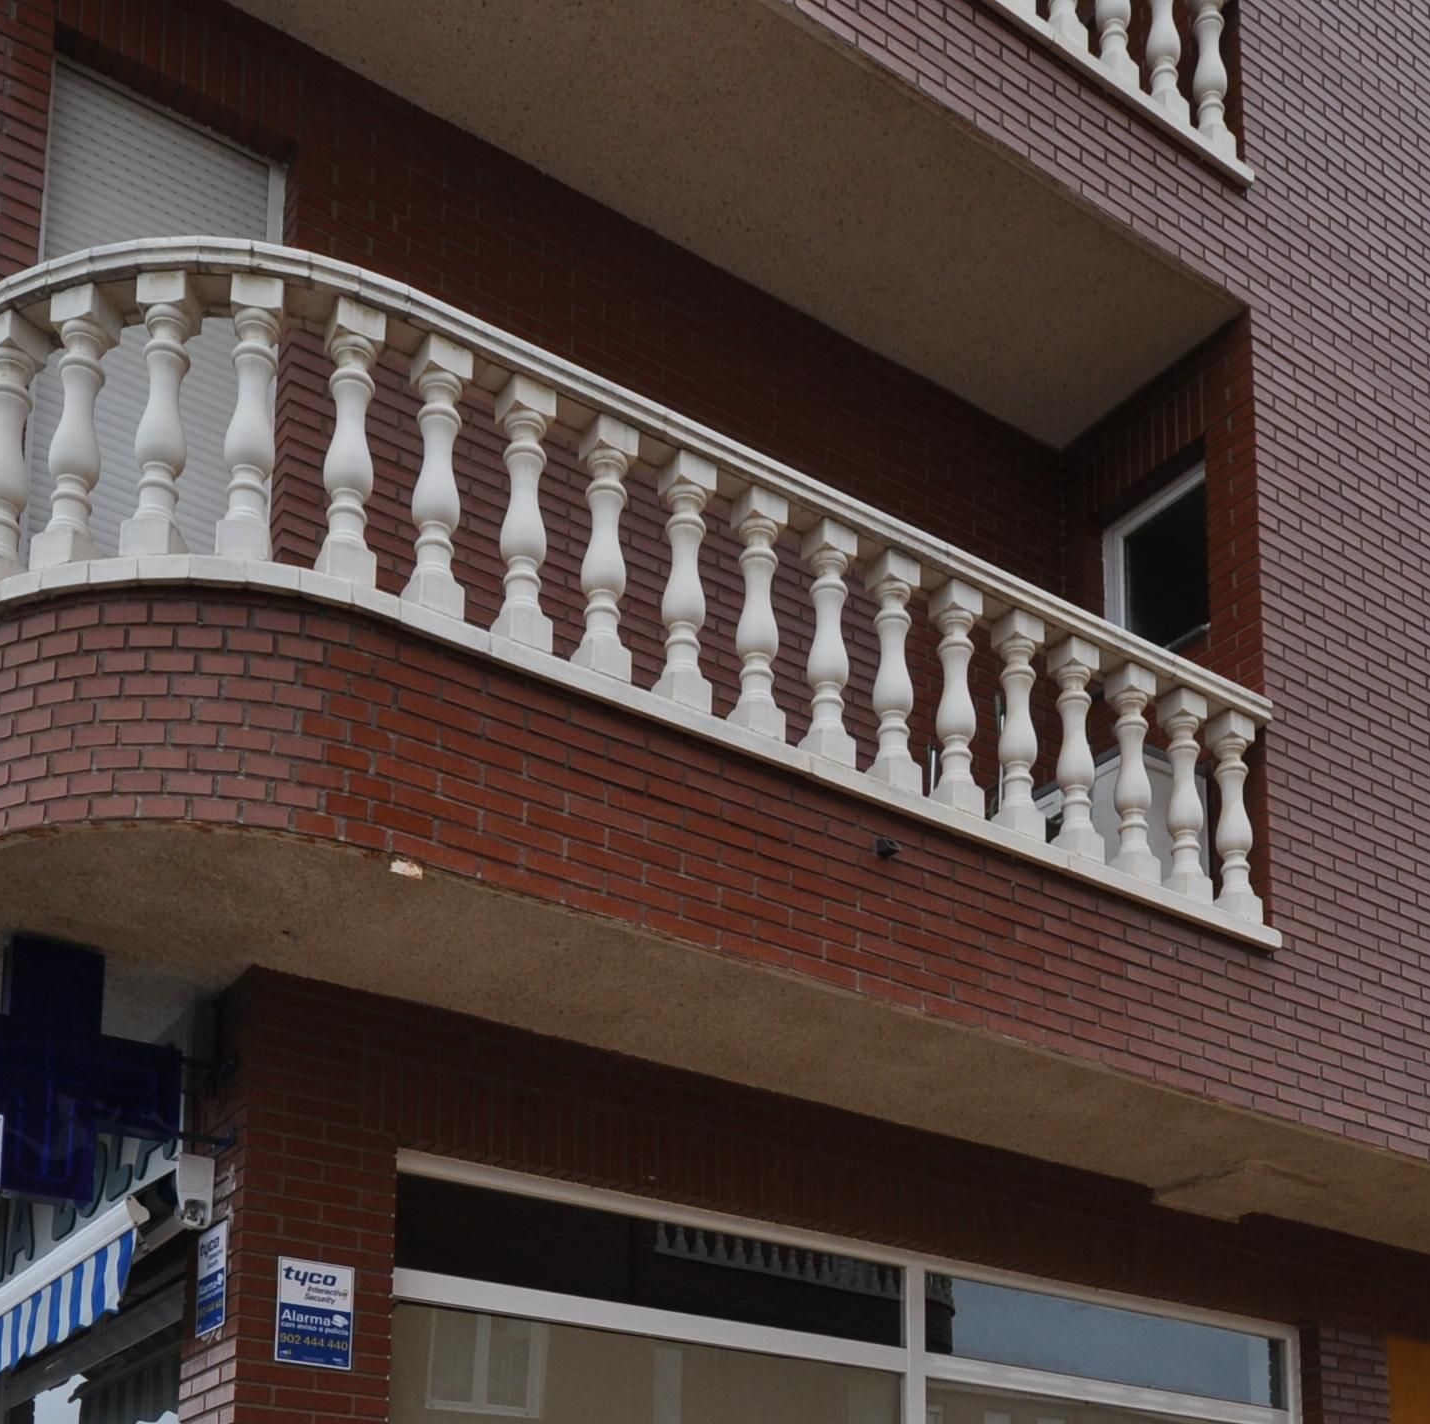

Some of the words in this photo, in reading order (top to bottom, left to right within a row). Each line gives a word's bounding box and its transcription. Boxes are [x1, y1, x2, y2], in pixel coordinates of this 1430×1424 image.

[283, 1266, 337, 1287] tyco
[303, 1293, 336, 1305] Security
[281, 1309, 331, 1327] Alarma
[279, 1333, 301, 1345] 902
[303, 1336, 324, 1348] 444
[327, 1339, 349, 1351] 440
